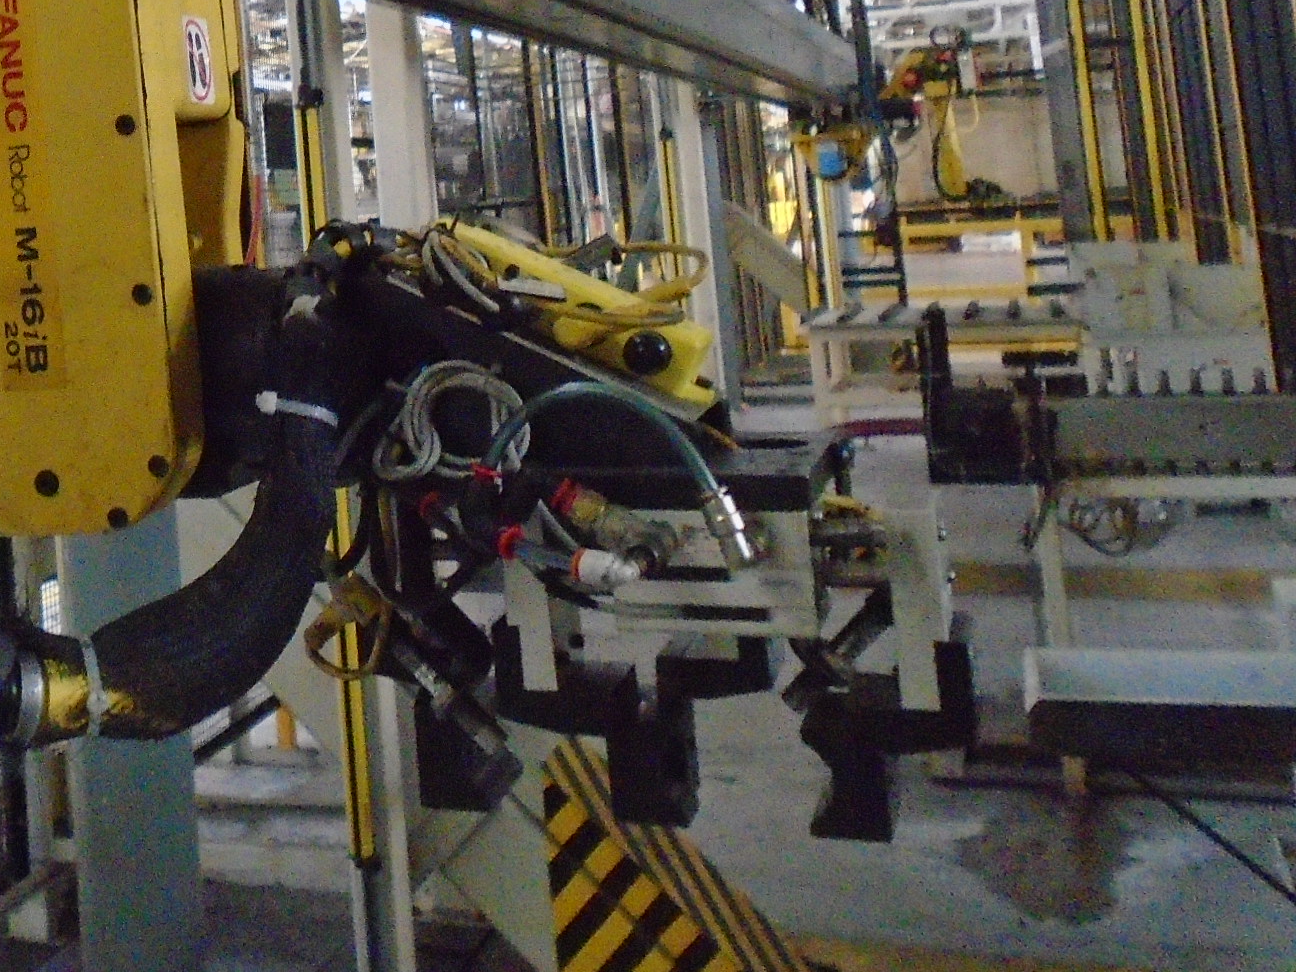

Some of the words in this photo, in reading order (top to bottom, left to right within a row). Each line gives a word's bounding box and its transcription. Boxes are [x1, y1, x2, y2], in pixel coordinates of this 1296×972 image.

[8, 144, 31, 213] Robot
[15, 226, 49, 374] M-16iB
[4, 321, 23, 375] 20T
